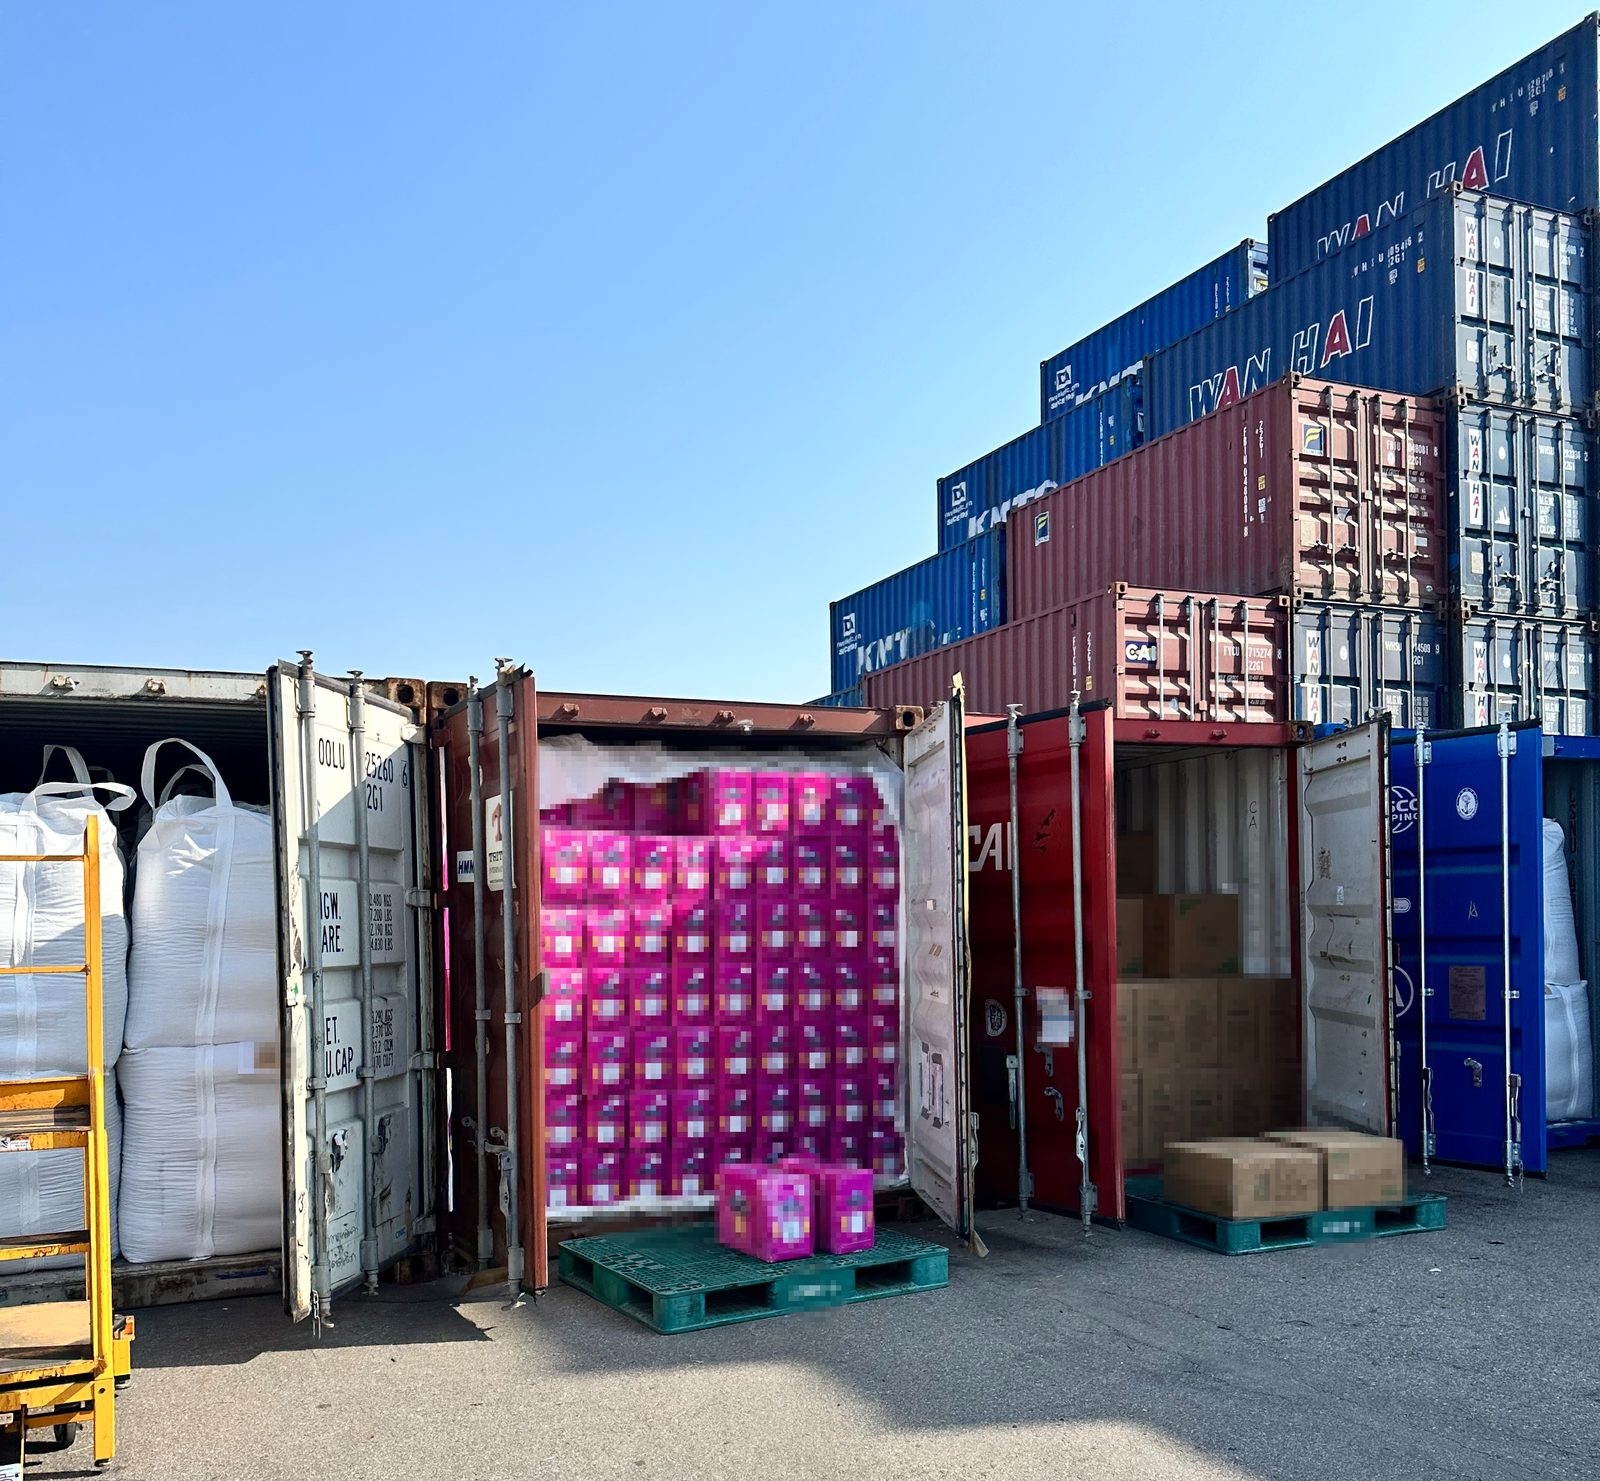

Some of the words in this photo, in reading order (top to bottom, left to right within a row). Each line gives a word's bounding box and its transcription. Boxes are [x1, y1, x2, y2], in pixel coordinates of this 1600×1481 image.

[1317, 192, 1403, 260] WAN
[1427, 129, 1512, 199] HAI
[1417, 231, 1423, 243] 2
[1467, 222, 1477, 259] WAN
[1468, 271, 1476, 307] HAI
[1189, 348, 1271, 422] WAN
[1289, 295, 1375, 376] HAI
[1470, 434, 1481, 471] WAN
[1472, 483, 1480, 519] HAI
[1126, 644, 1157, 662] CAI
[1308, 636, 1319, 674] WAN
[1412, 643, 1431, 654] 14509
[1435, 644, 1440, 655] 9
[1413, 655, 1424, 666] 2G1
[1475, 647, 1486, 683] WAN
[1310, 686, 1319, 723] HAI
[318, 737, 345, 770] OOLU
[365, 751, 394, 783] 25260
[402, 763, 408, 787] 6
[366, 783, 383, 812] 2G1
[489, 851, 502, 862] TRIT
[369, 893, 382, 907] 0.480
[369, 908, 382, 922] 7.200
[321, 924, 344, 953] ARE.
[325, 1016, 340, 1045] ET.
